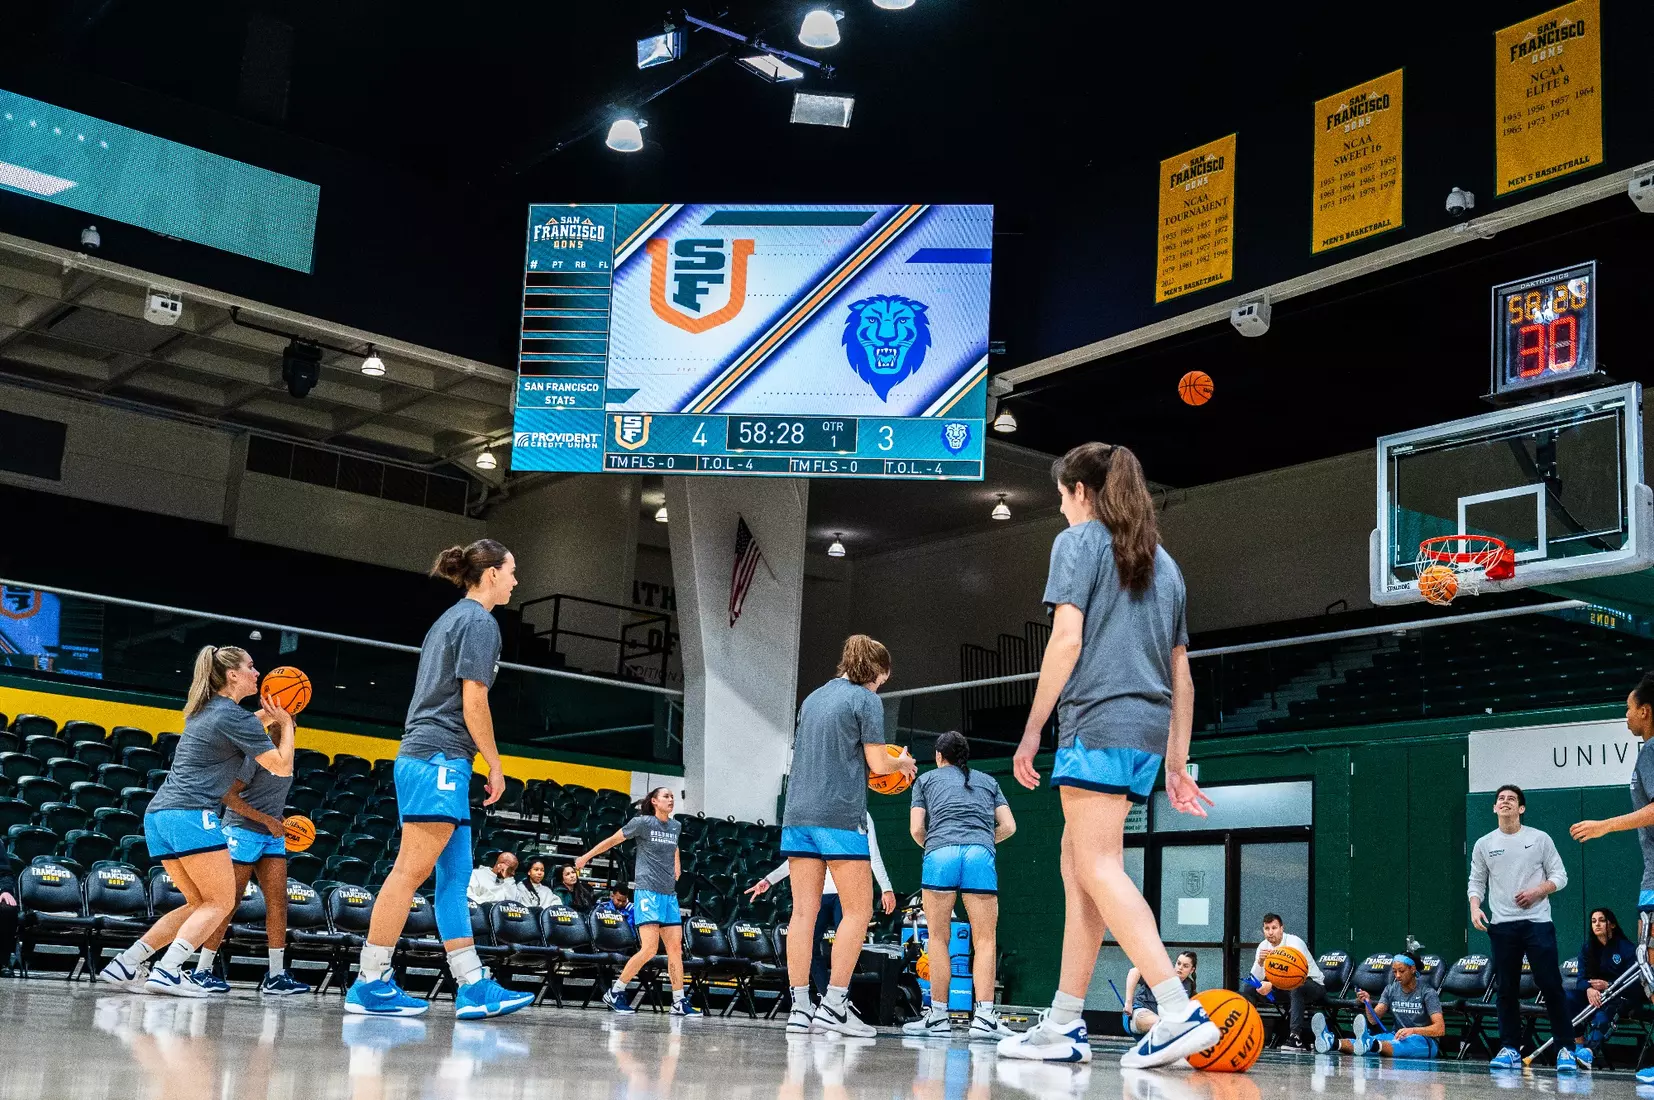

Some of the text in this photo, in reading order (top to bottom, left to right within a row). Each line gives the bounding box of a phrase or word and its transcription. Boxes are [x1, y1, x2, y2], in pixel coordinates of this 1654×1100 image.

[1537, 20, 1557, 35] SAN
[1510, 20, 1585, 64] FRANCISCO
[1532, 45, 1563, 64] DONS
[1531, 64, 1564, 84] NCAA
[1527, 75, 1570, 98] ELITE 8
[1350, 93, 1366, 106] SAN
[1503, 86, 1594, 124] 1955 1956 1957 1964
[1326, 93, 1389, 132] FRANCISCO
[1344, 116, 1371, 134] DONS
[1503, 109, 1570, 137] 1965 1973 1974
[1344, 135, 1372, 152] NCAA
[1190, 155, 1206, 166] SAN
[1334, 143, 1381, 167] SWEET 16
[1170, 156, 1224, 189] FRANCISCO
[1320, 155, 1397, 189] 1955 1956 1957 1958
[1535, 156, 1590, 178] BASKETBALL
[1185, 176, 1209, 192] DONS
[1320, 189, 1335, 201] 1963
[1380, 168, 1396, 180] 1972
[1184, 193, 1209, 209] NCAA
[1320, 200, 1335, 212] 1973
[1339, 194, 1355, 205] 1974
[1380, 179, 1396, 191] 1979
[1164, 196, 1228, 226] TOURNAMENT
[560, 216, 580, 224] SAN
[1346, 218, 1392, 239] BASKETBALL
[533, 224, 605, 241] FRANCISCO
[553, 240, 584, 249] DONS
[552, 261, 563, 269] PT
[1184, 272, 1224, 291] BASKETBALL
[1520, 273, 1569, 290] DAKTRONICS
[1519, 314, 1577, 379] 30
[524, 382, 599, 392] SAN FRANCISCO
[545, 396, 576, 405] STATS
[692, 421, 708, 447] 4
[739, 422, 805, 444] 58:28
[822, 422, 844, 432] QTR
[531, 433, 601, 443] PROVIDENT
[831, 435, 837, 448] 1
[877, 425, 894, 451] 3
[610, 456, 628, 468] TM
[631, 457, 655, 469] FLS
[667, 458, 675, 469] 0
[745, 459, 753, 471] 4
[791, 460, 810, 471] TM
[814, 461, 838, 472] FLS
[850, 461, 858, 472] 0
[935, 463, 943, 475] 4
[32, 867, 71, 878] FRANCISCO
[98, 871, 136, 882] FRANCISCO
[640, 899, 649, 911] C
[1269, 961, 1289, 972] NCAA
